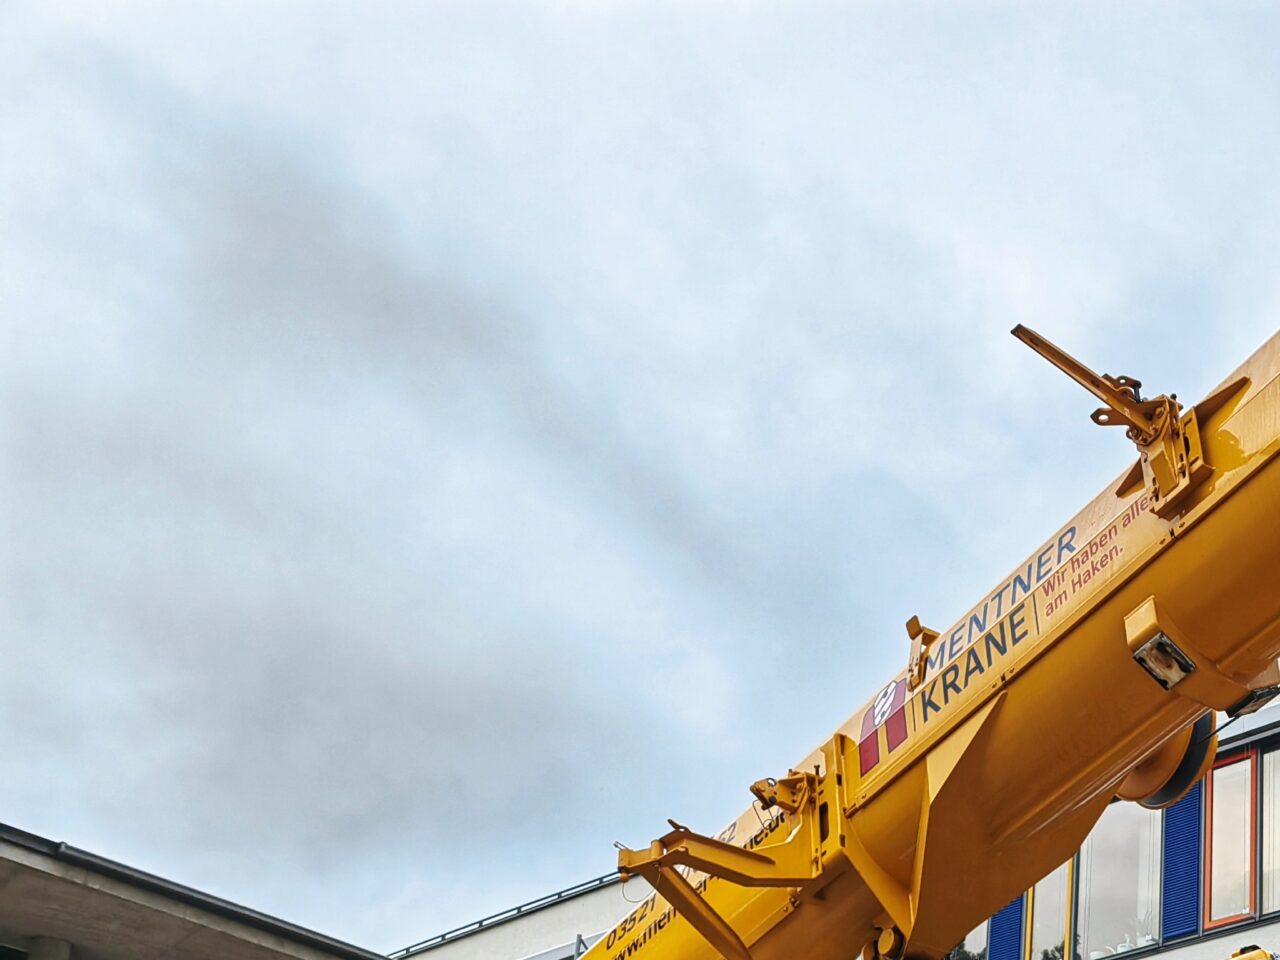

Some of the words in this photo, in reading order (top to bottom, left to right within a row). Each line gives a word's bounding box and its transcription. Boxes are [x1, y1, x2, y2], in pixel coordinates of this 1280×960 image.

[1042, 568, 1068, 598] Wir
[1070, 525, 1118, 574] haben
[1122, 496, 1150, 528] alle
[1045, 592, 1068, 617] am
[1071, 545, 1123, 594] Haken.
[924, 526, 1076, 681] MENTNER
[921, 604, 1028, 723] KRANE
